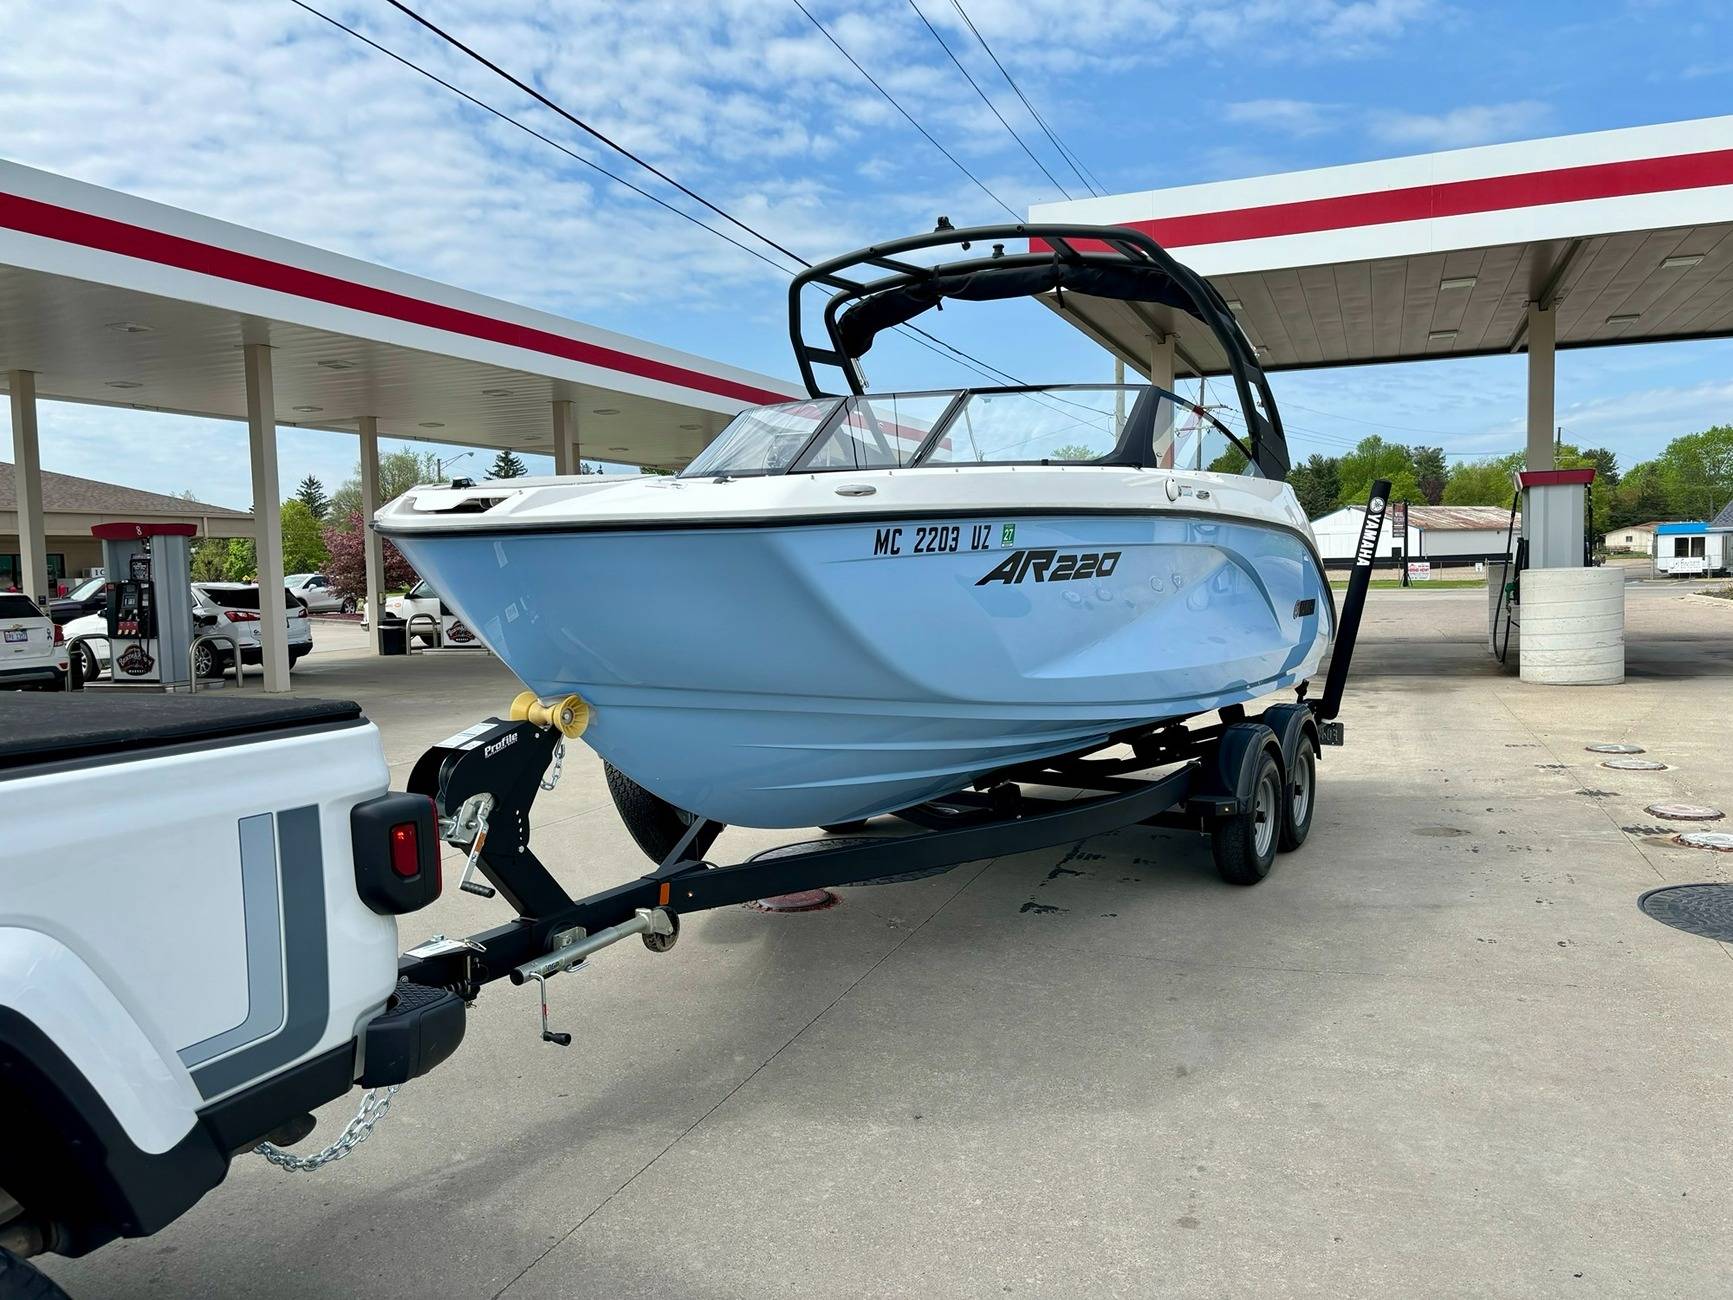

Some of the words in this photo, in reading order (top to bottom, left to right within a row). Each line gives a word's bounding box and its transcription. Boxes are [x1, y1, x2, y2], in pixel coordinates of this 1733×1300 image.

[873, 528, 903, 555] MC
[913, 526, 960, 553] 2203
[971, 524, 992, 550] UZ
[1003, 528, 1014, 540] 27
[1356, 514, 1382, 566] YAMAHA
[974, 549, 1123, 586] AR220
[484, 732, 518, 758] Profile
